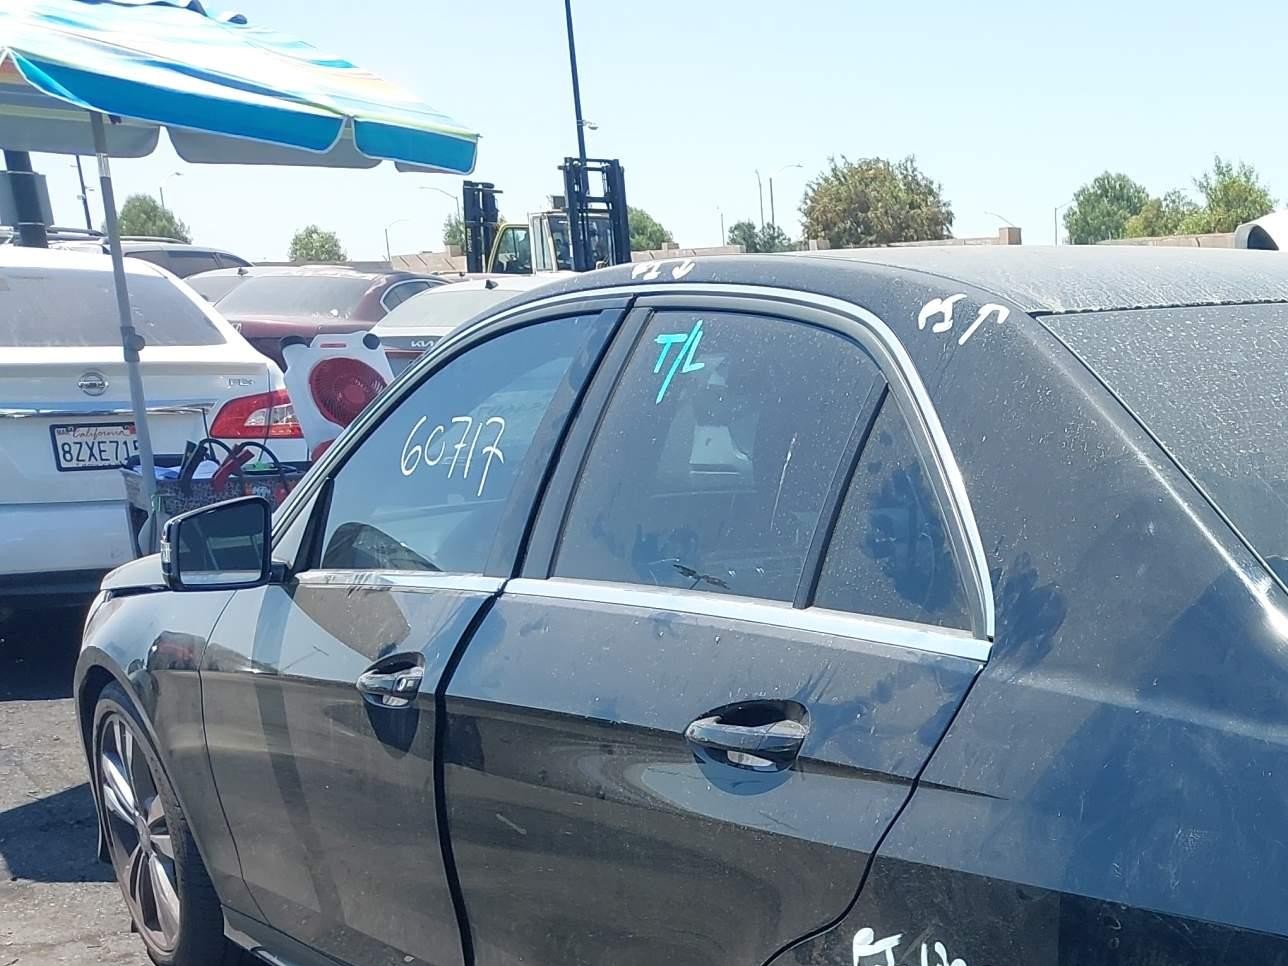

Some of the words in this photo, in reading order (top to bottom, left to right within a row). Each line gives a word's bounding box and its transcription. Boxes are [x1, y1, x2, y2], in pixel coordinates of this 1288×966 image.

[654, 320, 705, 405] T/L
[61, 440, 139, 463] 8ZXE71
[401, 415, 505, 497] 60717
